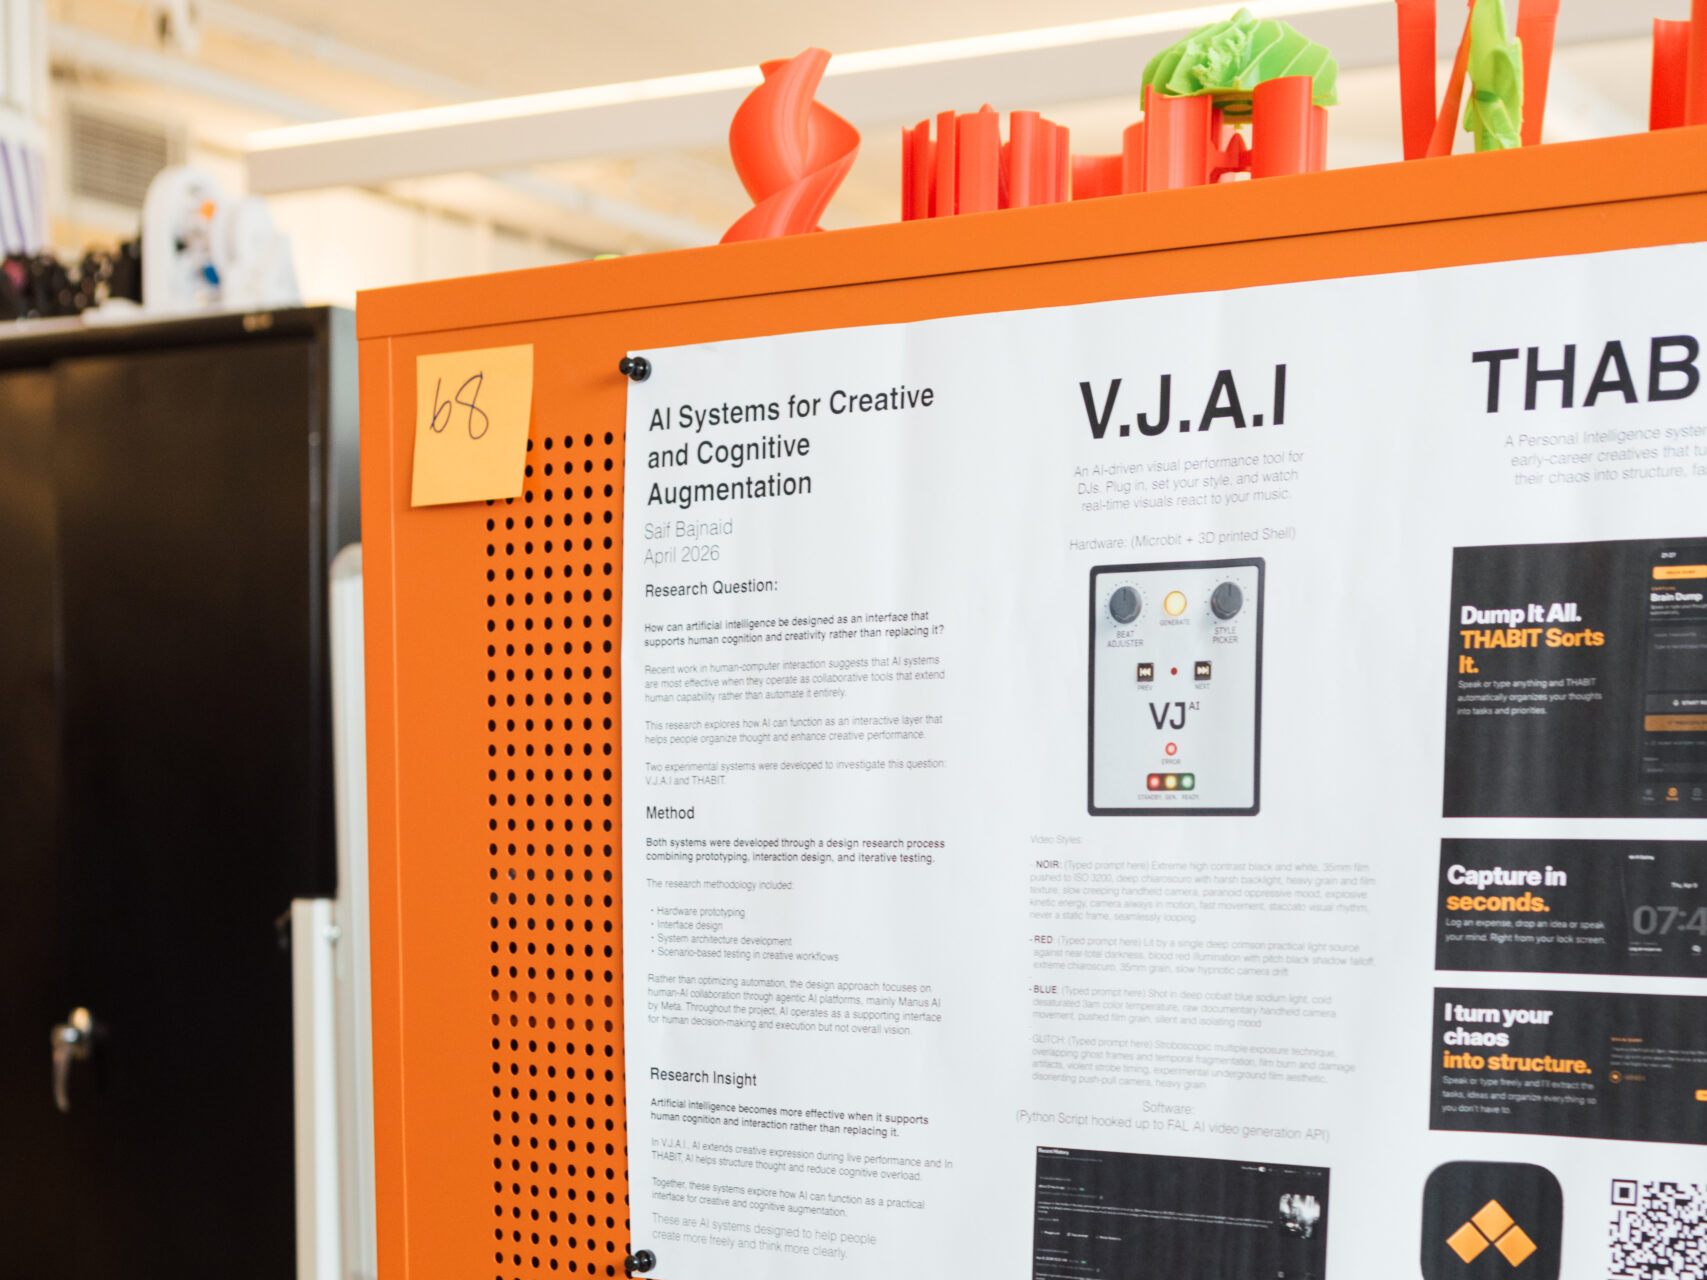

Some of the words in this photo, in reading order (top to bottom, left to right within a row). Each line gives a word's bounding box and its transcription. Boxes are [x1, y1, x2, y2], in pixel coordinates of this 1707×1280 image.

[650, 408, 670, 431] AI
[678, 401, 781, 435] Systems
[787, 395, 821, 418] for
[829, 386, 934, 414] Creative
[1079, 364, 1287, 439] V.J.A.I
[648, 443, 688, 469] and
[696, 434, 810, 468] Cognitive
[648, 472, 811, 509] Augmentation
[644, 523, 671, 540] Saif
[675, 519, 732, 540] Bajnaid
[644, 548, 676, 567] April
[680, 546, 720, 562] 2026
[645, 582, 707, 597] Research
[712, 578, 777, 594] Question:
[645, 623, 664, 632] How
[666, 623, 683, 631] can
[685, 620, 722, 630] artificial
[725, 618, 776, 631] intelligence
[778, 617, 789, 627] be
[791, 615, 834, 628] designed
[865, 613, 908, 622] interface
[910, 612, 928, 621] that
[1461, 605, 1524, 628] Dump
[1528, 604, 1544, 622] It
[1546, 602, 1582, 622] All.
[645, 636, 685, 648] supports
[687, 635, 719, 645] human
[721, 633, 762, 646] cognition
[765, 632, 782, 642] and
[784, 630, 826, 641] creativity
[828, 629, 857, 639] rather
[859, 628, 881, 637] than
[885, 626, 929, 638] replacing
[931, 626, 944, 634] it?
[1460, 628, 1542, 649] THABIT
[1546, 628, 1605, 648] Sorts
[1459, 655, 1479, 674] It.
[1149, 702, 1186, 730] VJ
[647, 806, 694, 819] Method
[647, 838, 667, 847] Both
[669, 838, 707, 849] systems
[733, 838, 779, 849] developed
[781, 838, 815, 849] through
[826, 838, 859, 849] design
[861, 838, 904, 847] research
[906, 841, 945, 850] process
[647, 852, 693, 863] combining
[695, 852, 750, 863] prototyping,
[752, 852, 798, 861] interaction
[800, 853, 834, 864] design,
[836, 853, 855, 862] and
[858, 853, 897, 862] iterative
[899, 853, 935, 865] testing.
[1448, 864, 1542, 890] Capture
[1546, 866, 1567, 886] in
[1447, 892, 1550, 912] seconds.
[1444, 1003, 1452, 1022] I
[1454, 1004, 1500, 1023] turn
[1503, 1008, 1552, 1028] your
[1444, 1027, 1509, 1047] chaos
[1443, 1050, 1484, 1070] into
[1488, 1053, 1592, 1074] structure.
[651, 1068, 709, 1083] Research
[712, 1071, 756, 1089] Insight
[651, 1097, 686, 1108] Artificial
[688, 1100, 736, 1113] intelligence
[738, 1103, 777, 1114] becomes
[779, 1108, 803, 1116] more
[805, 1108, 845, 1119] effective
[847, 1111, 873, 1121] when
[875, 1112, 882, 1121] it
[884, 1114, 928, 1125] supports
[651, 1111, 680, 1121] human
[681, 1114, 721, 1125] cognition
[723, 1117, 739, 1126] and
[741, 1117, 787, 1129] interaction
[789, 1121, 817, 1131] rather
[819, 1123, 840, 1133] than
[842, 1125, 887, 1138] replacing
[890, 1127, 899, 1137] it.
